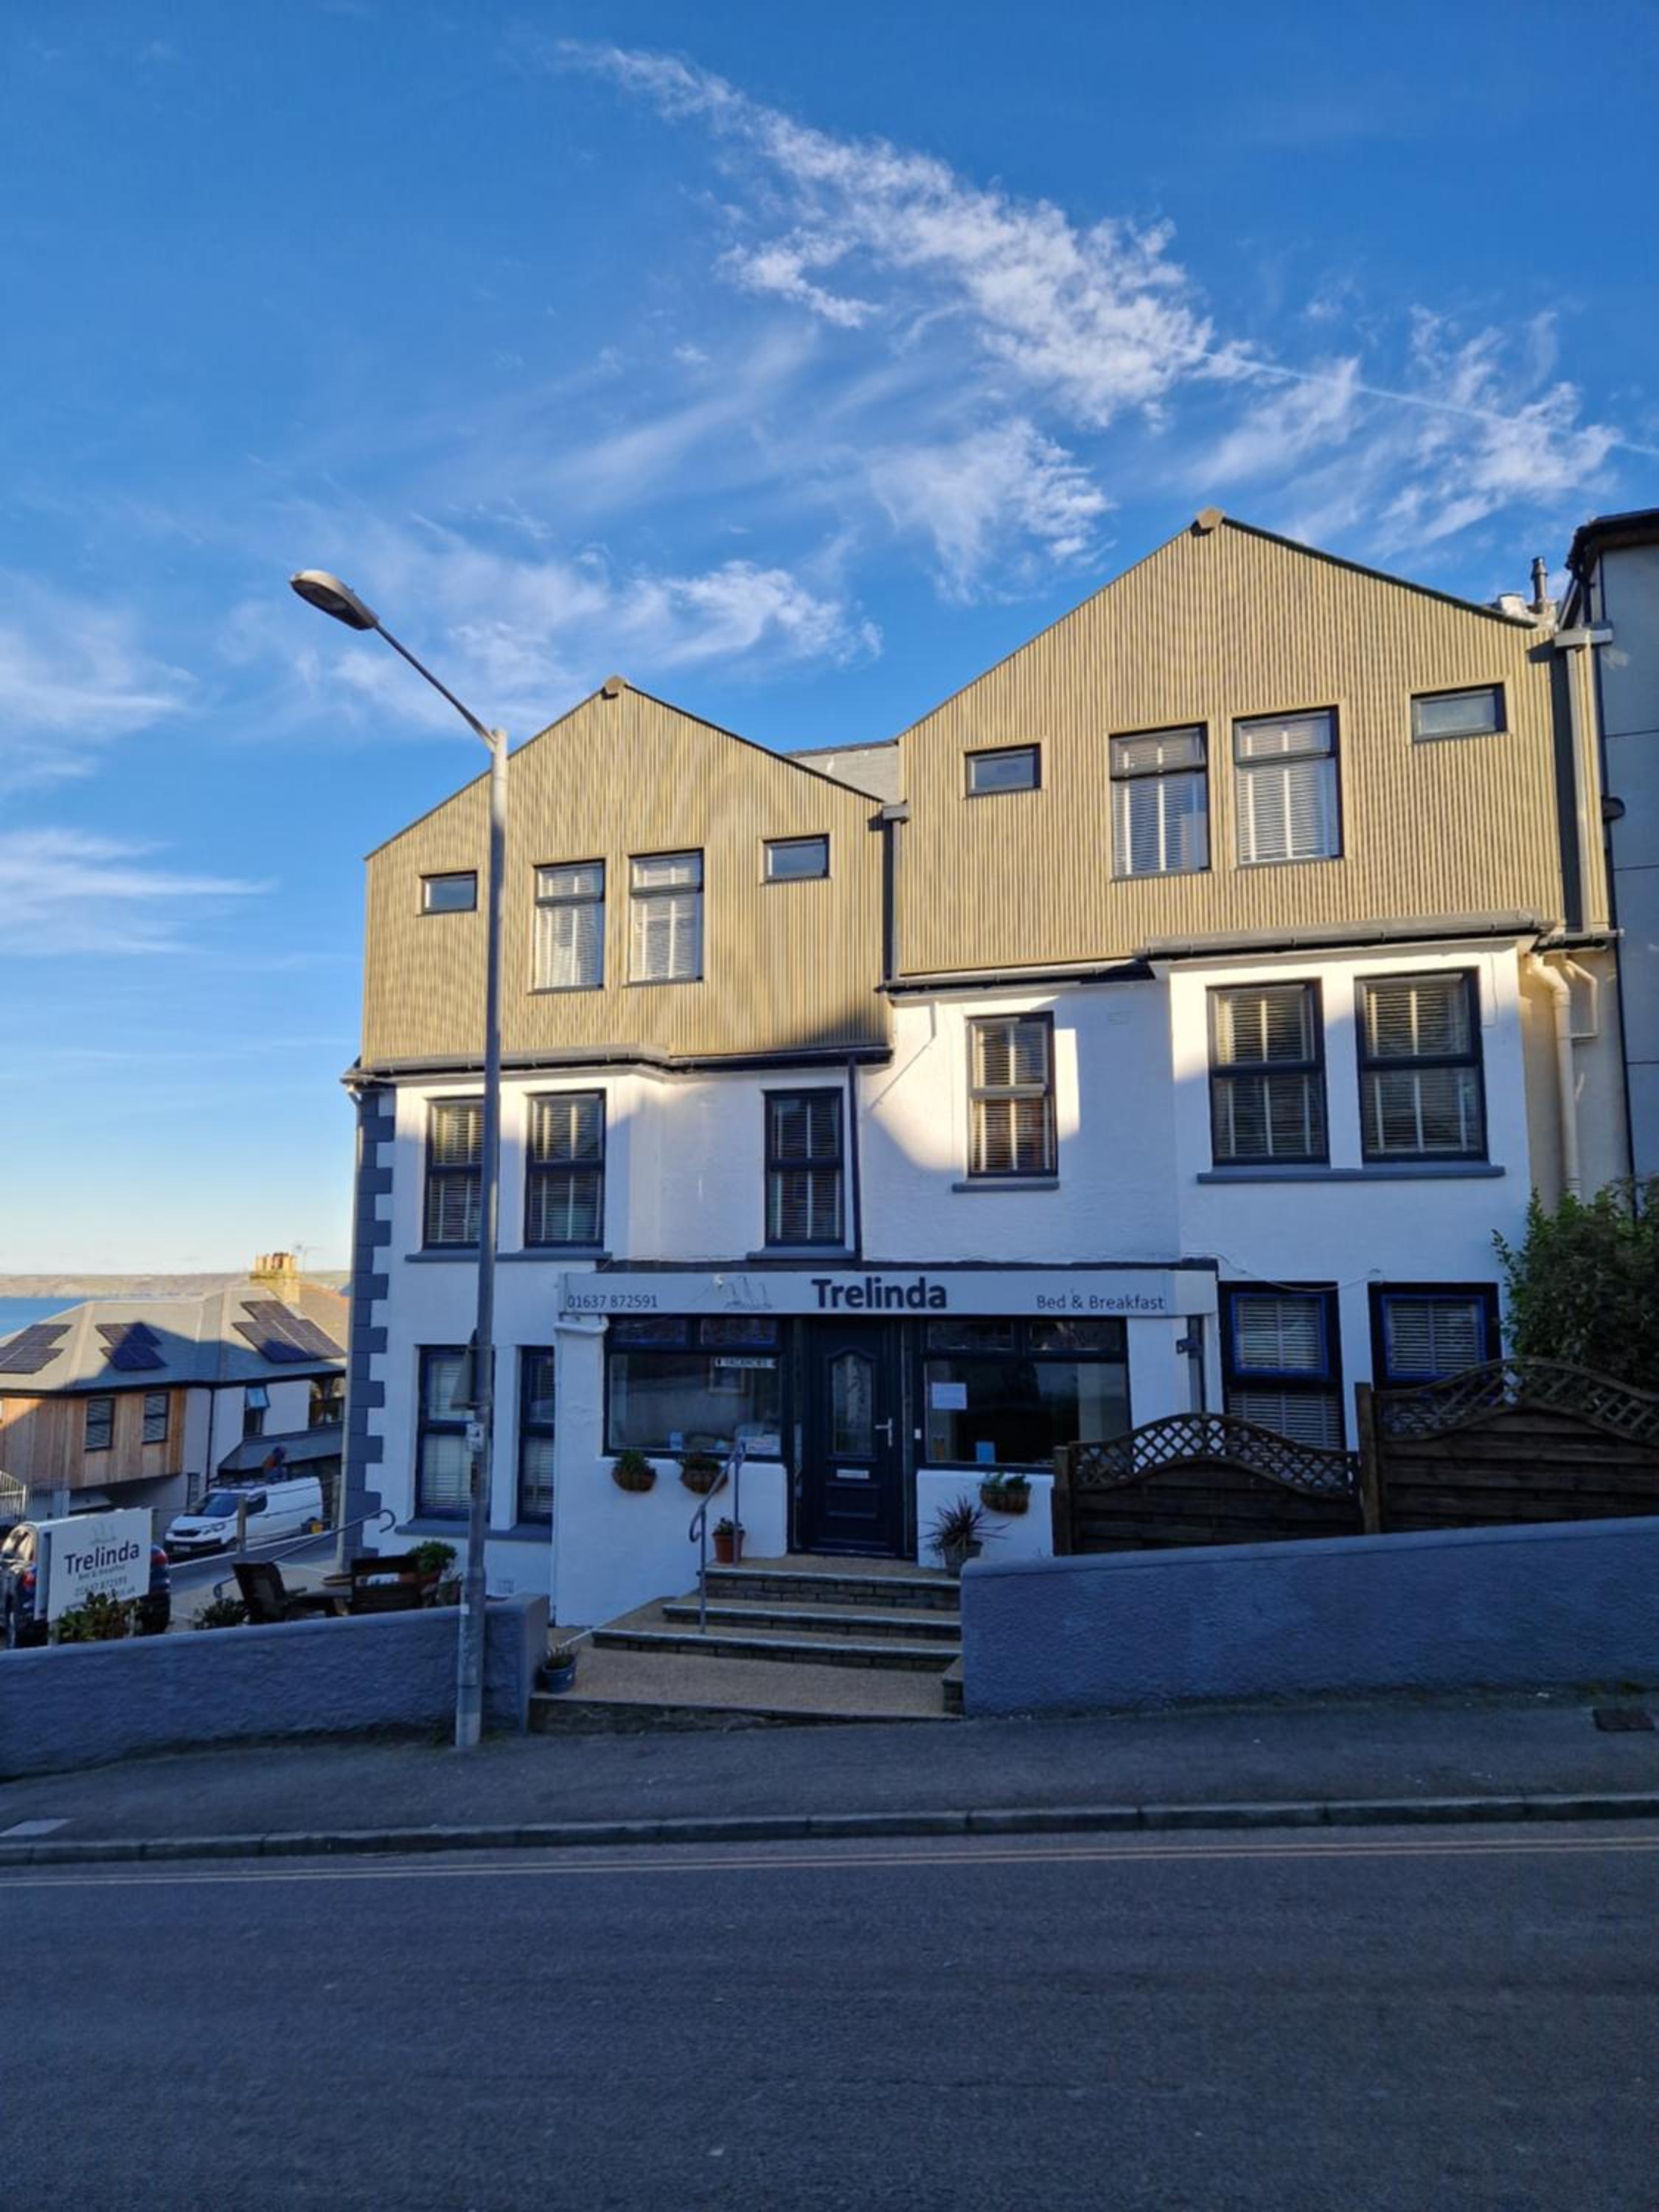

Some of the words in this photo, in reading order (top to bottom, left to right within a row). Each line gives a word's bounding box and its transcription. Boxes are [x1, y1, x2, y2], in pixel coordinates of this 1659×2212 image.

[567, 1295, 606, 1308] 01637
[610, 1295, 658, 1308] 872591
[811, 1276, 947, 1309] Trelinda
[1036, 1295, 1066, 1309] Bed
[1071, 1295, 1083, 1309] &
[1089, 1294, 1166, 1310] Breakfast
[64, 1540, 139, 1575] Trelinda
